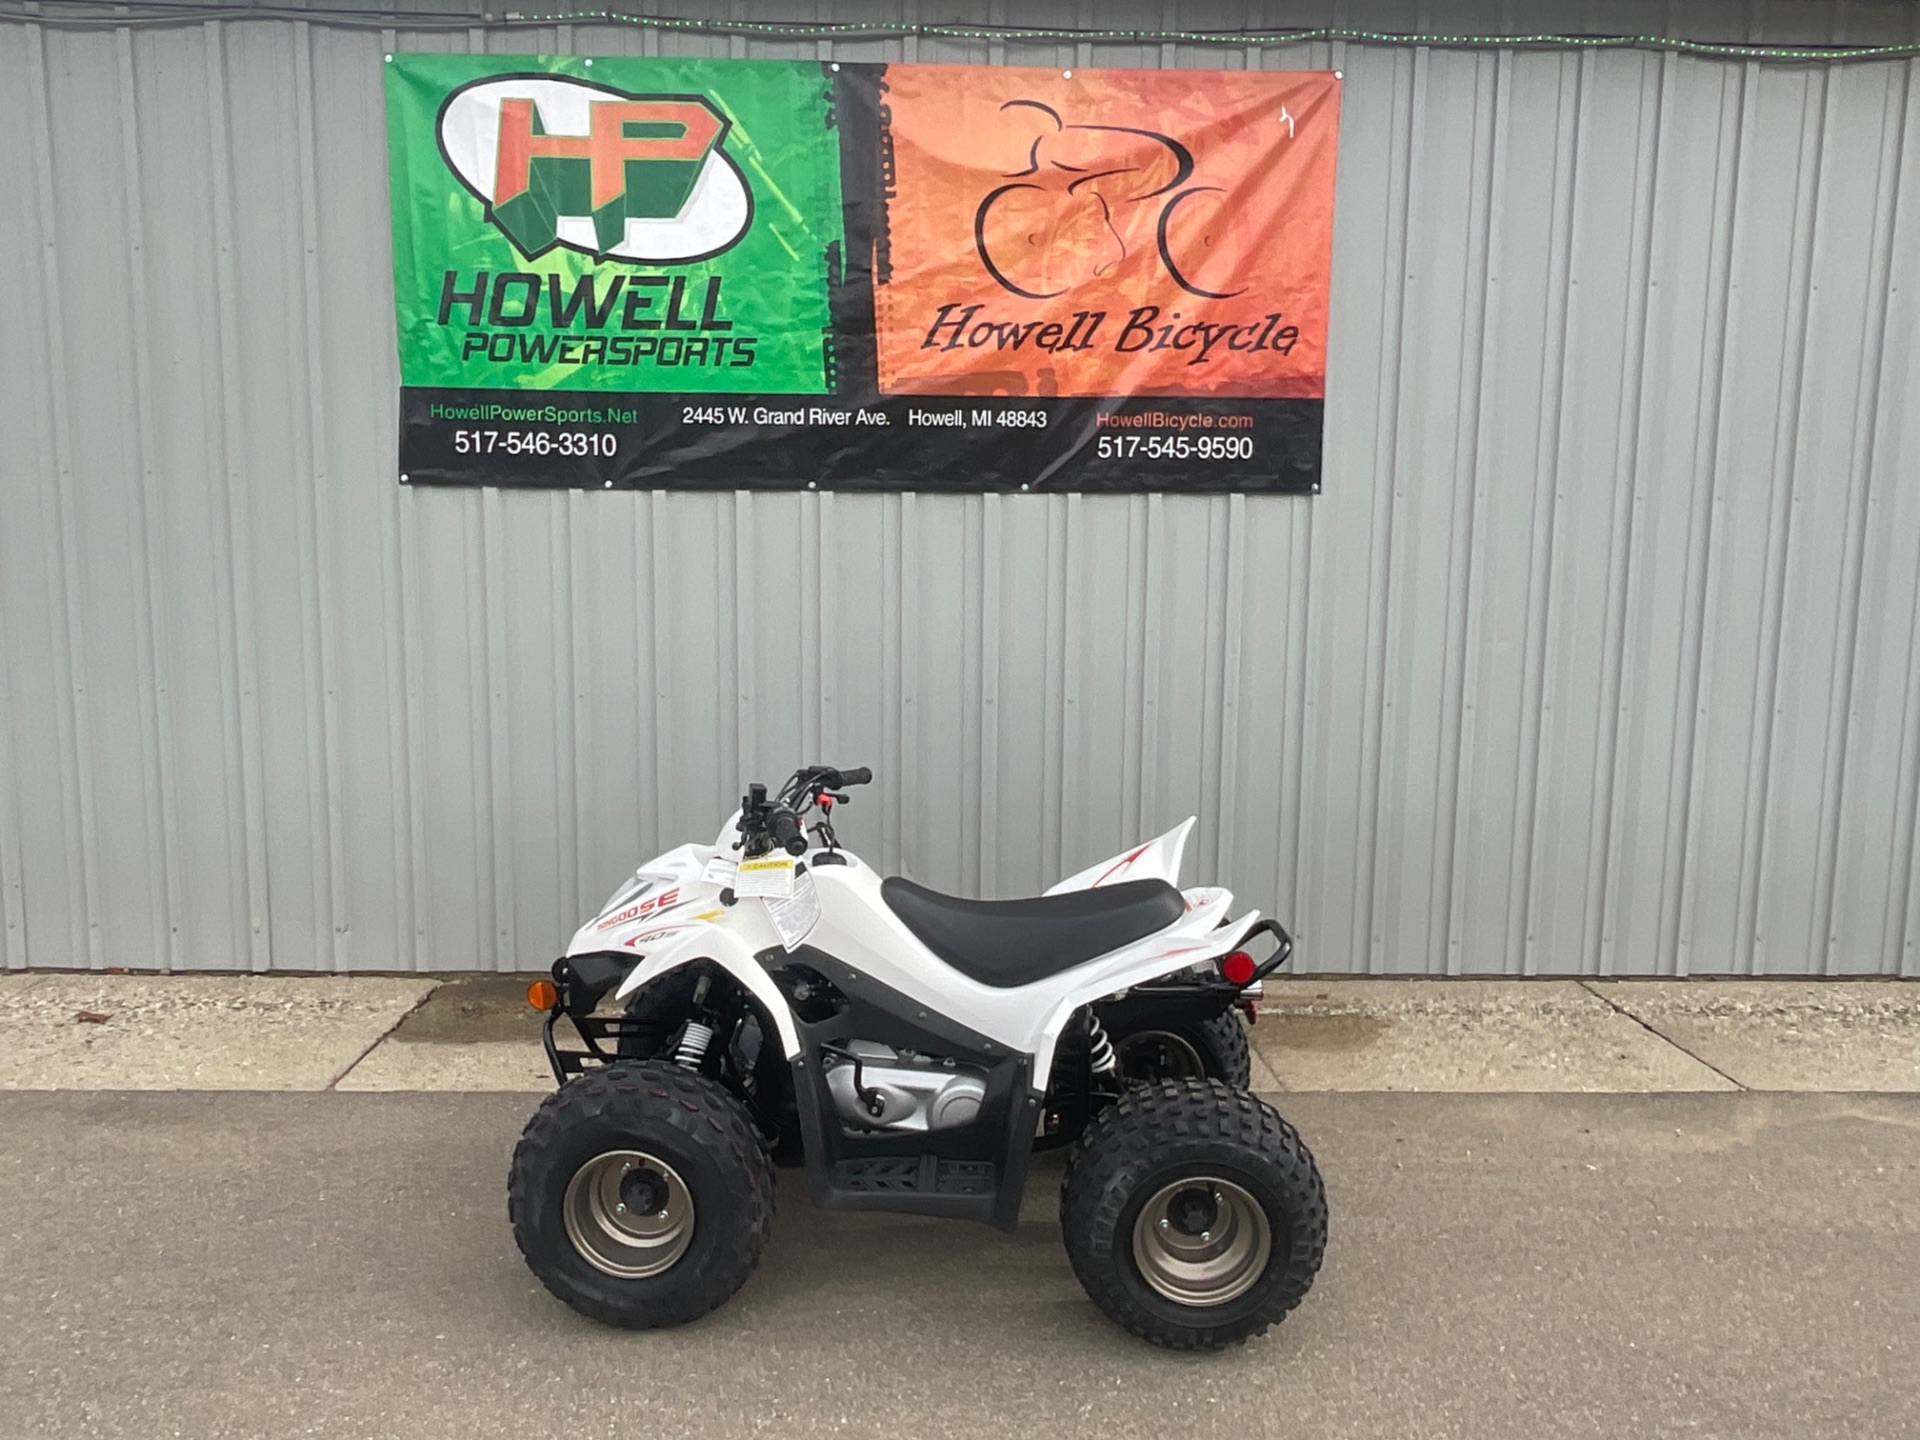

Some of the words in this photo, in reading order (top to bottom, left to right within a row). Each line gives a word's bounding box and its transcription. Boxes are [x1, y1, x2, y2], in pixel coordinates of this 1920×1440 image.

[492, 97, 724, 256] HP
[437, 271, 734, 331] HOWELL
[920, 303, 1107, 353] Howell
[1114, 305, 1299, 366] Bicycle
[461, 332, 758, 367] POWERSPORTS
[430, 403, 638, 425] HowellPowerSports.Net
[682, 407, 725, 425] 2445
[728, 408, 749, 425] W.
[753, 408, 805, 426] Grand
[809, 408, 852, 426] River
[855, 409, 891, 427] Ave.
[908, 409, 967, 429] Howell,
[971, 410, 992, 427] MI
[996, 410, 1047, 428] 48843
[1096, 412, 1254, 431] HowellBicycle.com
[454, 430, 618, 457] 517-546-3310
[1097, 436, 1254, 460] 517-545-9590
